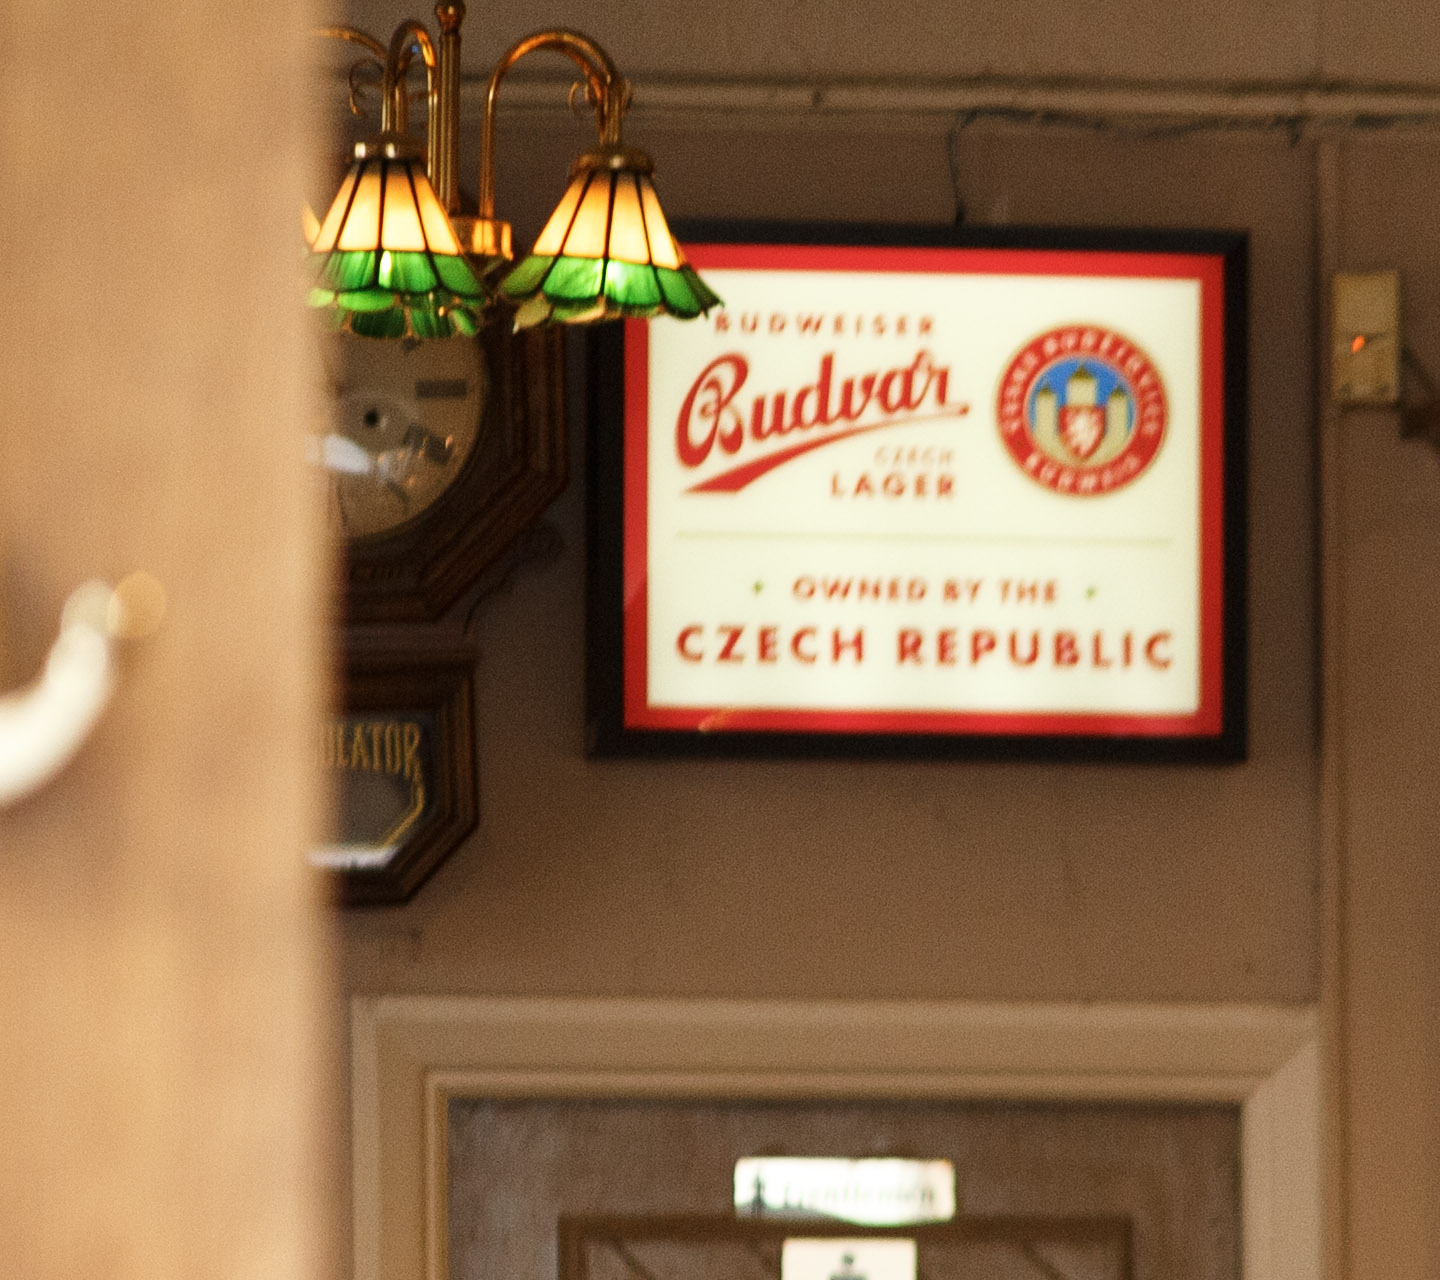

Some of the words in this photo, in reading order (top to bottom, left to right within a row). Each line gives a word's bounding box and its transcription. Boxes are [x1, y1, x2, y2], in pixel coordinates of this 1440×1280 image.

[714, 311, 935, 338] BUDWEISER
[675, 348, 970, 468] Budvar
[875, 445, 955, 466] CZECH
[830, 472, 956, 499] LAGER
[792, 577, 928, 603] OWNED
[942, 579, 983, 604] BY
[998, 580, 1057, 604] THE
[675, 624, 866, 665] CZECH
[896, 628, 1175, 670] REPUBLIC
